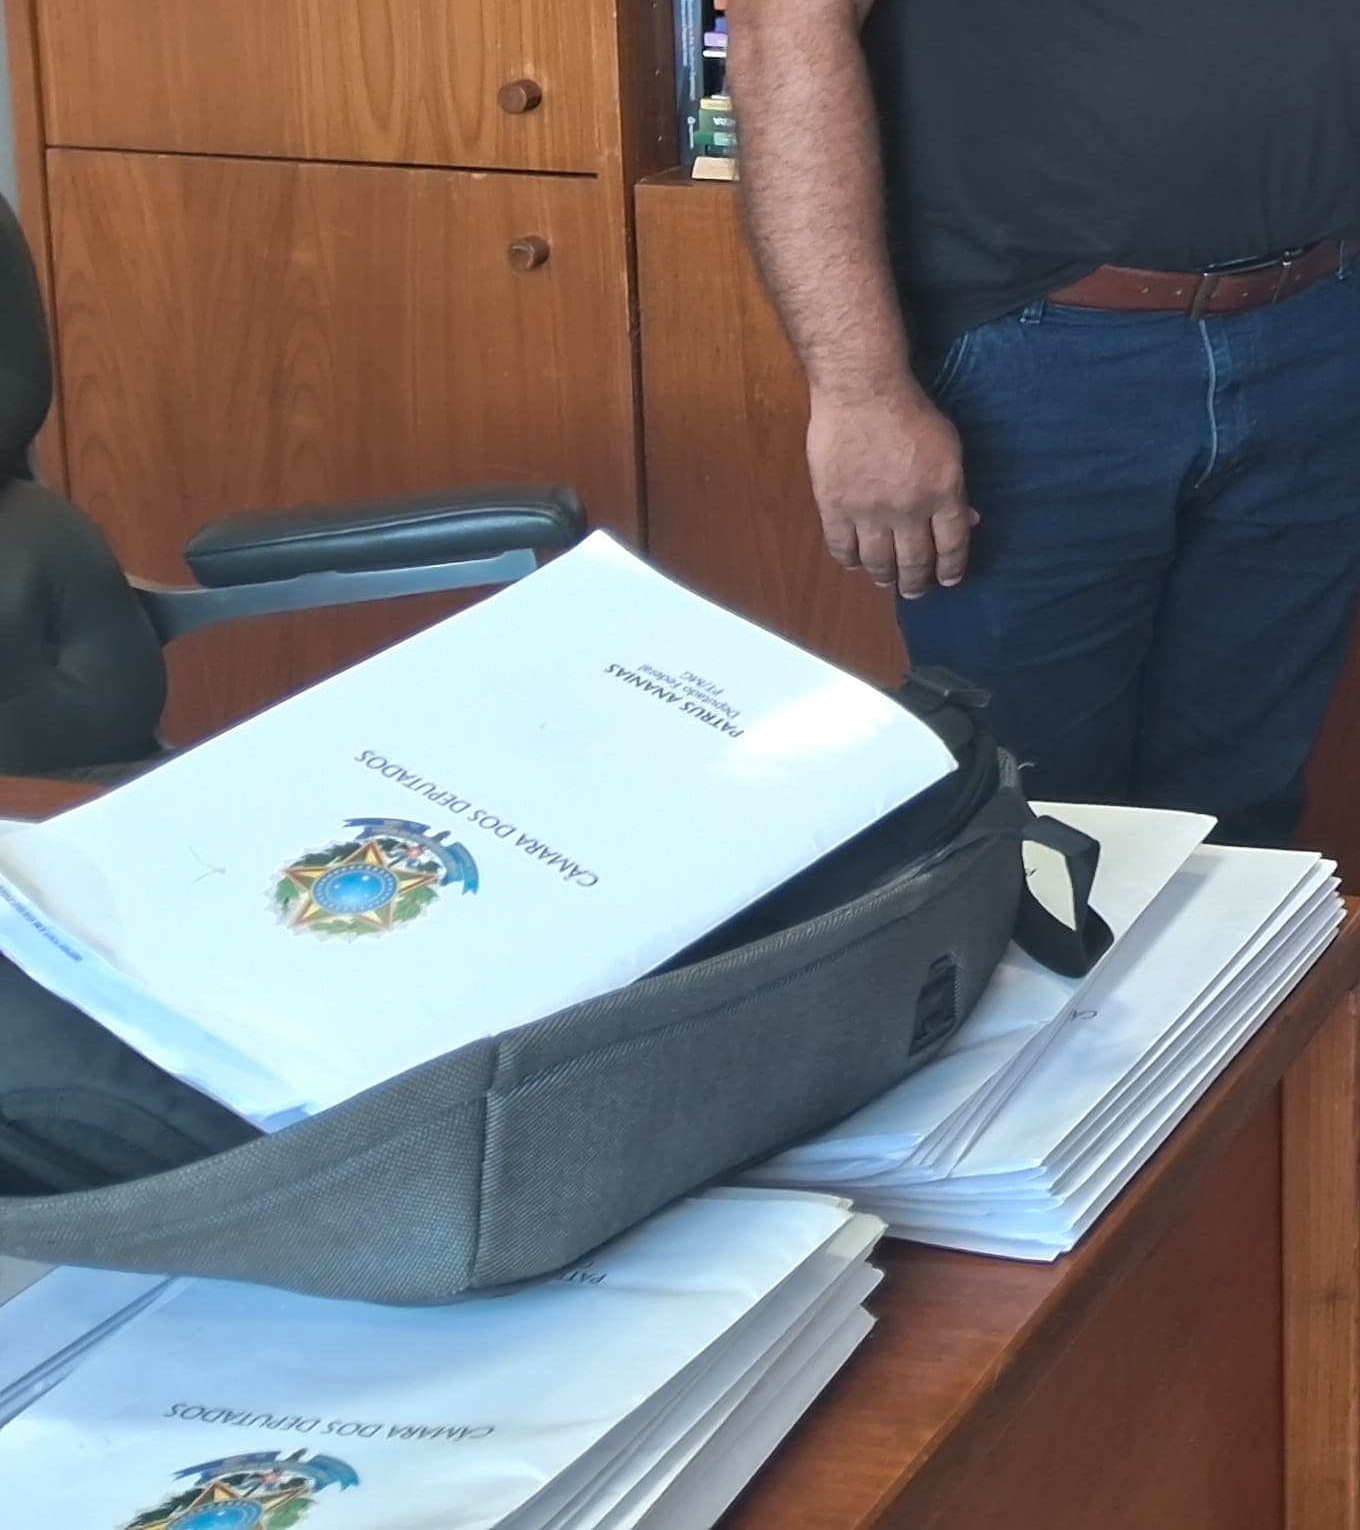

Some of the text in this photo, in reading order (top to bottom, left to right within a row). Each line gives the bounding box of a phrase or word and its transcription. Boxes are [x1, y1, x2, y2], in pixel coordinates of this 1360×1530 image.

[604, 663, 744, 738] PATRUS ANANIAS
[637, 664, 741, 719] Deputado Federal
[680, 671, 725, 696] PT/MG
[354, 749, 599, 888] CÂMARA DOS DEPUTADOS
[163, 1402, 496, 1442] CÂMARA DOS DEPUTADOS
